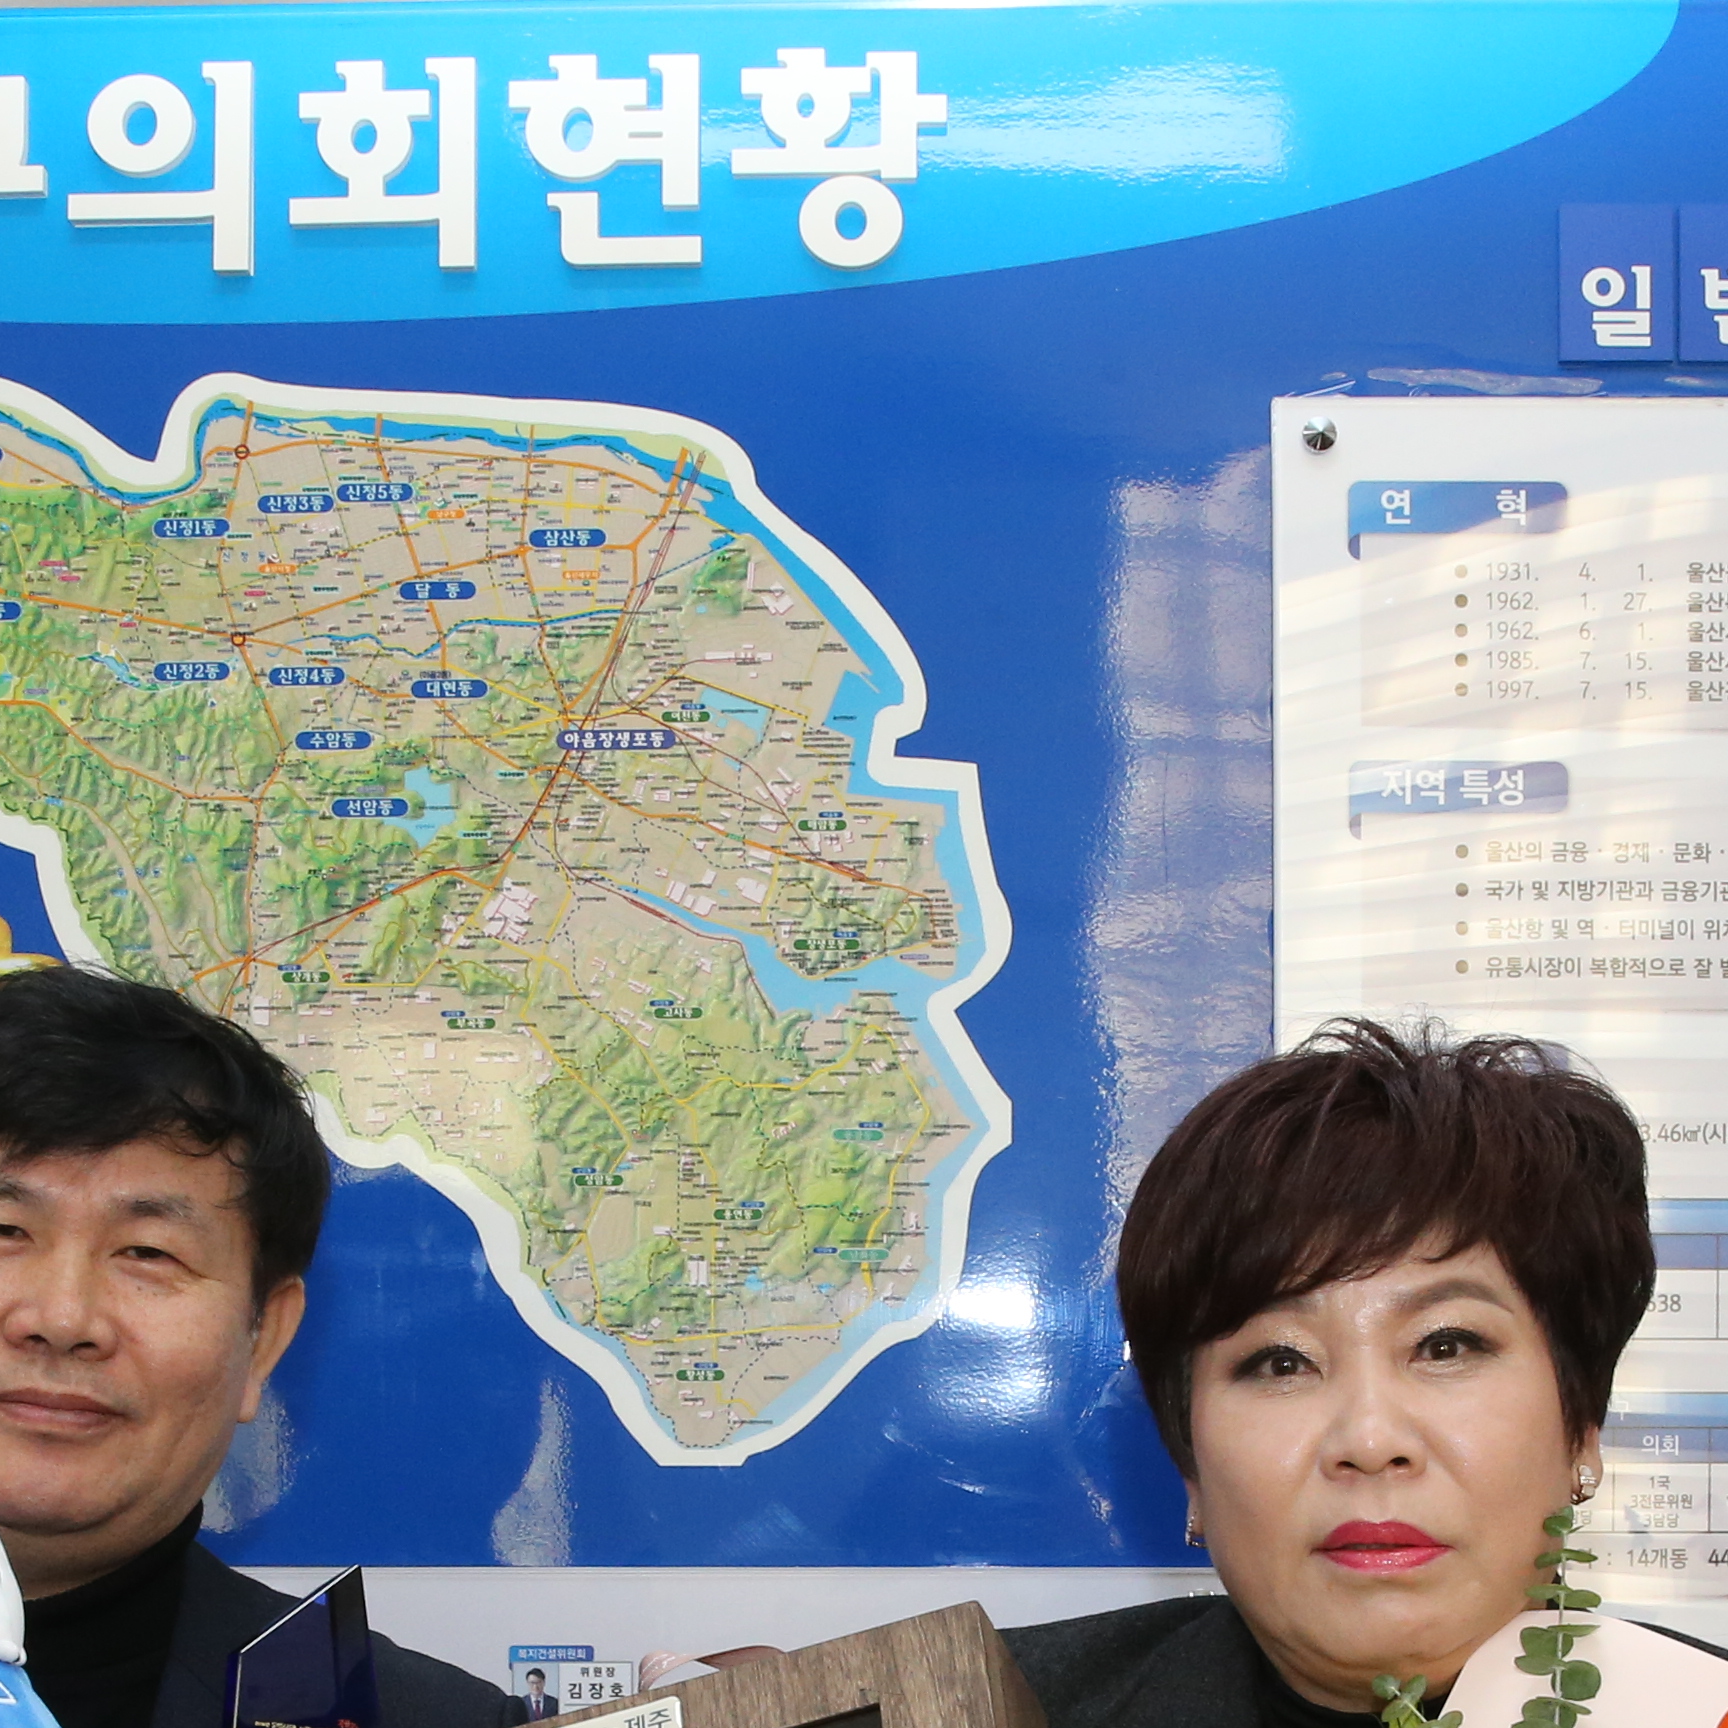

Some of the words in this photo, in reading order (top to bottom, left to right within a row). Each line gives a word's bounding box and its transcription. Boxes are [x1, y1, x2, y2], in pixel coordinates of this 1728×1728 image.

[345, 482, 403, 501] 신정5동
[267, 494, 325, 512] 신정3동
[162, 518, 217, 537] 신정1동
[544, 529, 591, 547] 삼산동
[163, 662, 220, 682] 신정2동
[278, 666, 336, 685] 신정4동
[427, 679, 472, 698] 대현동
[310, 731, 356, 750] 수암동
[563, 729, 665, 750] 야음장생포동
[1381, 769, 1447, 803] 지역
[1459, 770, 1524, 804] 특성
[347, 798, 393, 817] 선암동
[1485, 880, 1524, 901] 국가
[1531, 880, 1549, 901] 및
[1557, 879, 1654, 902] 지방기관과
[1486, 957, 1581, 978] 유통시장이
[1589, 957, 1687, 979] 복합적으로
[1693, 957, 1714, 979] 잘
[1627, 1548, 1688, 1570] 14개동
